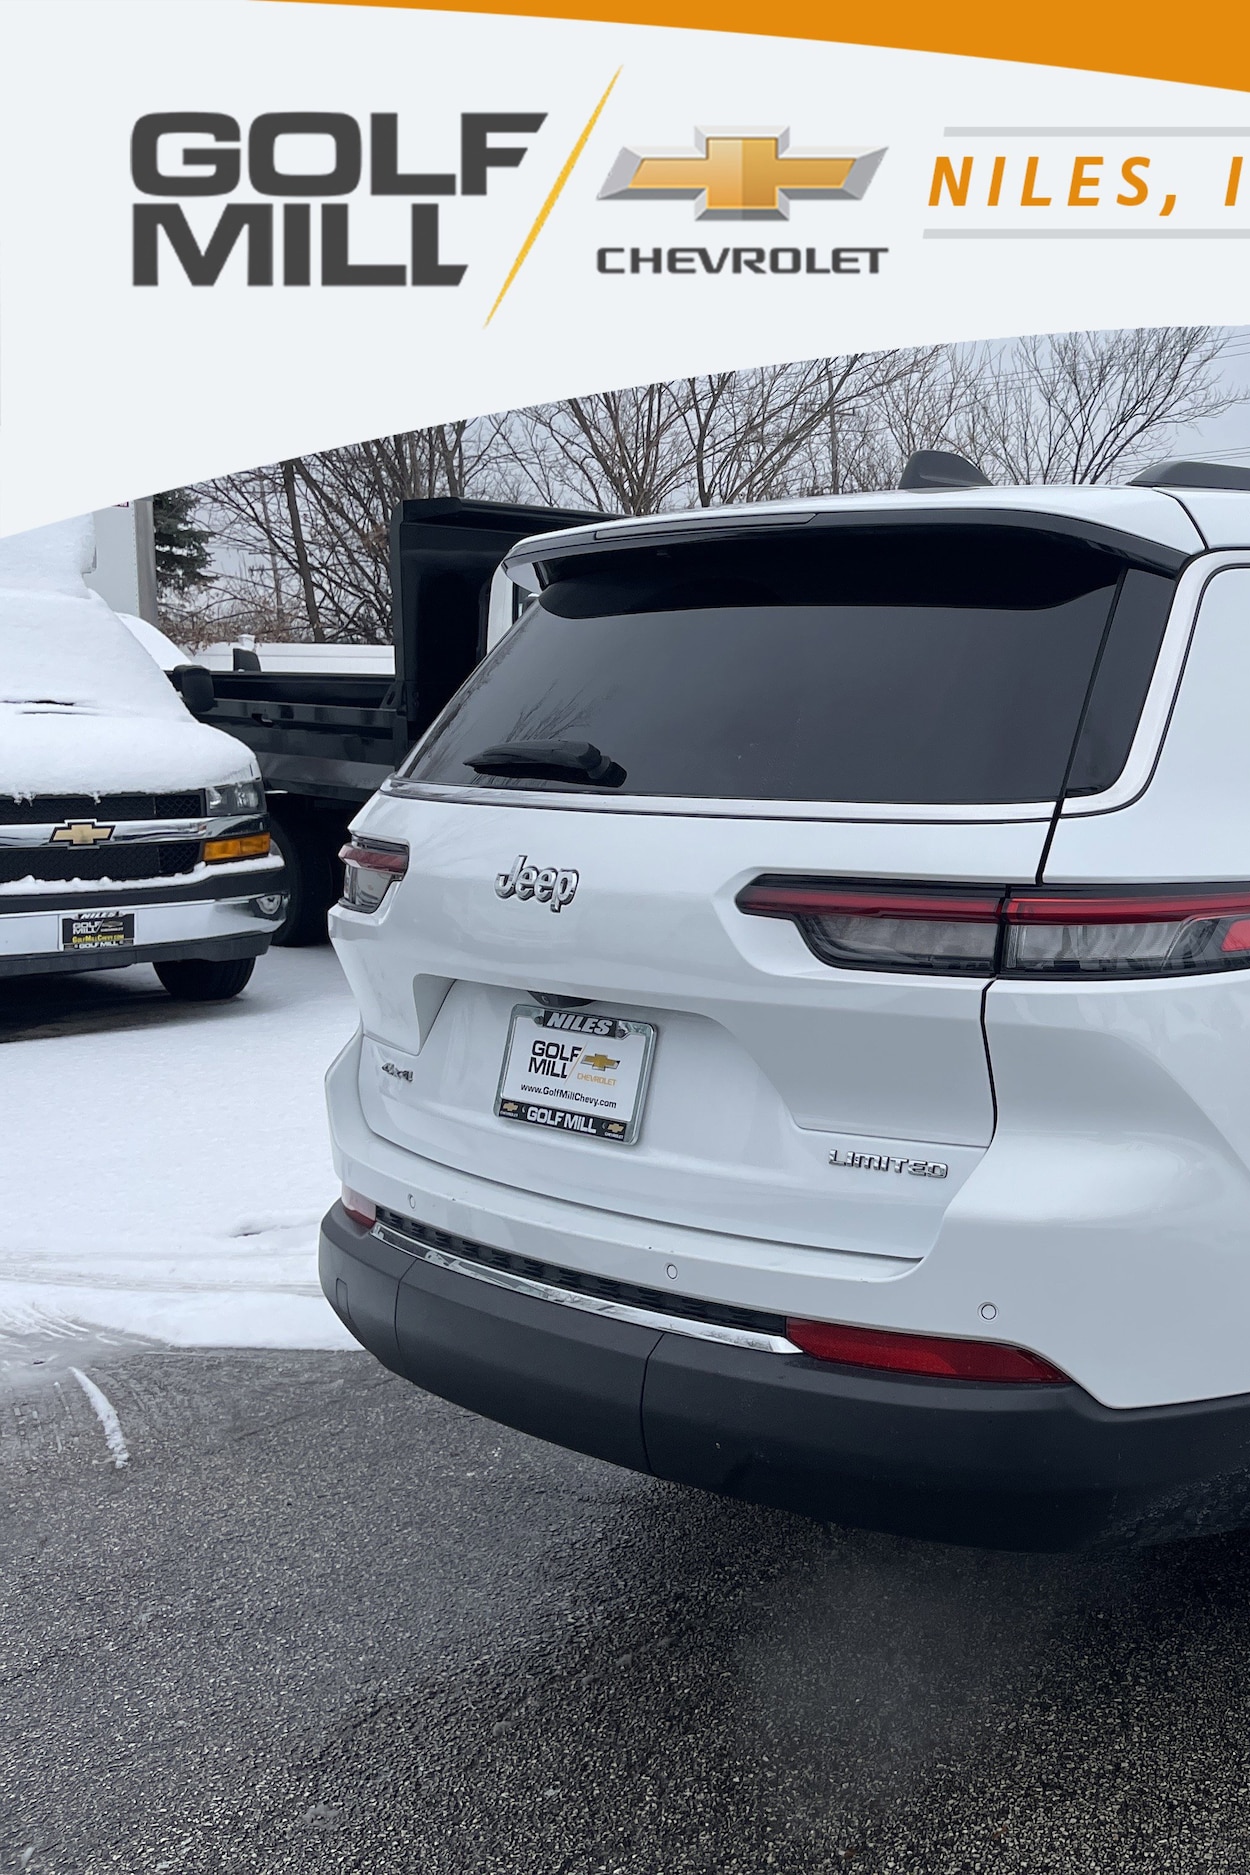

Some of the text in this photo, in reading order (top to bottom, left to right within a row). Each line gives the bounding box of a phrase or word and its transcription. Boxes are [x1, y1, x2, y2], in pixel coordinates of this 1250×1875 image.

[494, 854, 579, 913] Jeep
[72, 921, 100, 929] GOLF
[546, 1012, 613, 1036] NILES
[531, 1040, 583, 1063] GOLF
[528, 1056, 568, 1079] MILL
[576, 1072, 617, 1087] CHEVROLET
[520, 1083, 617, 1109] www.GolfMillChevy.com
[526, 1106, 597, 1134] GOLF MILL
[828, 1149, 949, 1179] LIMITED
